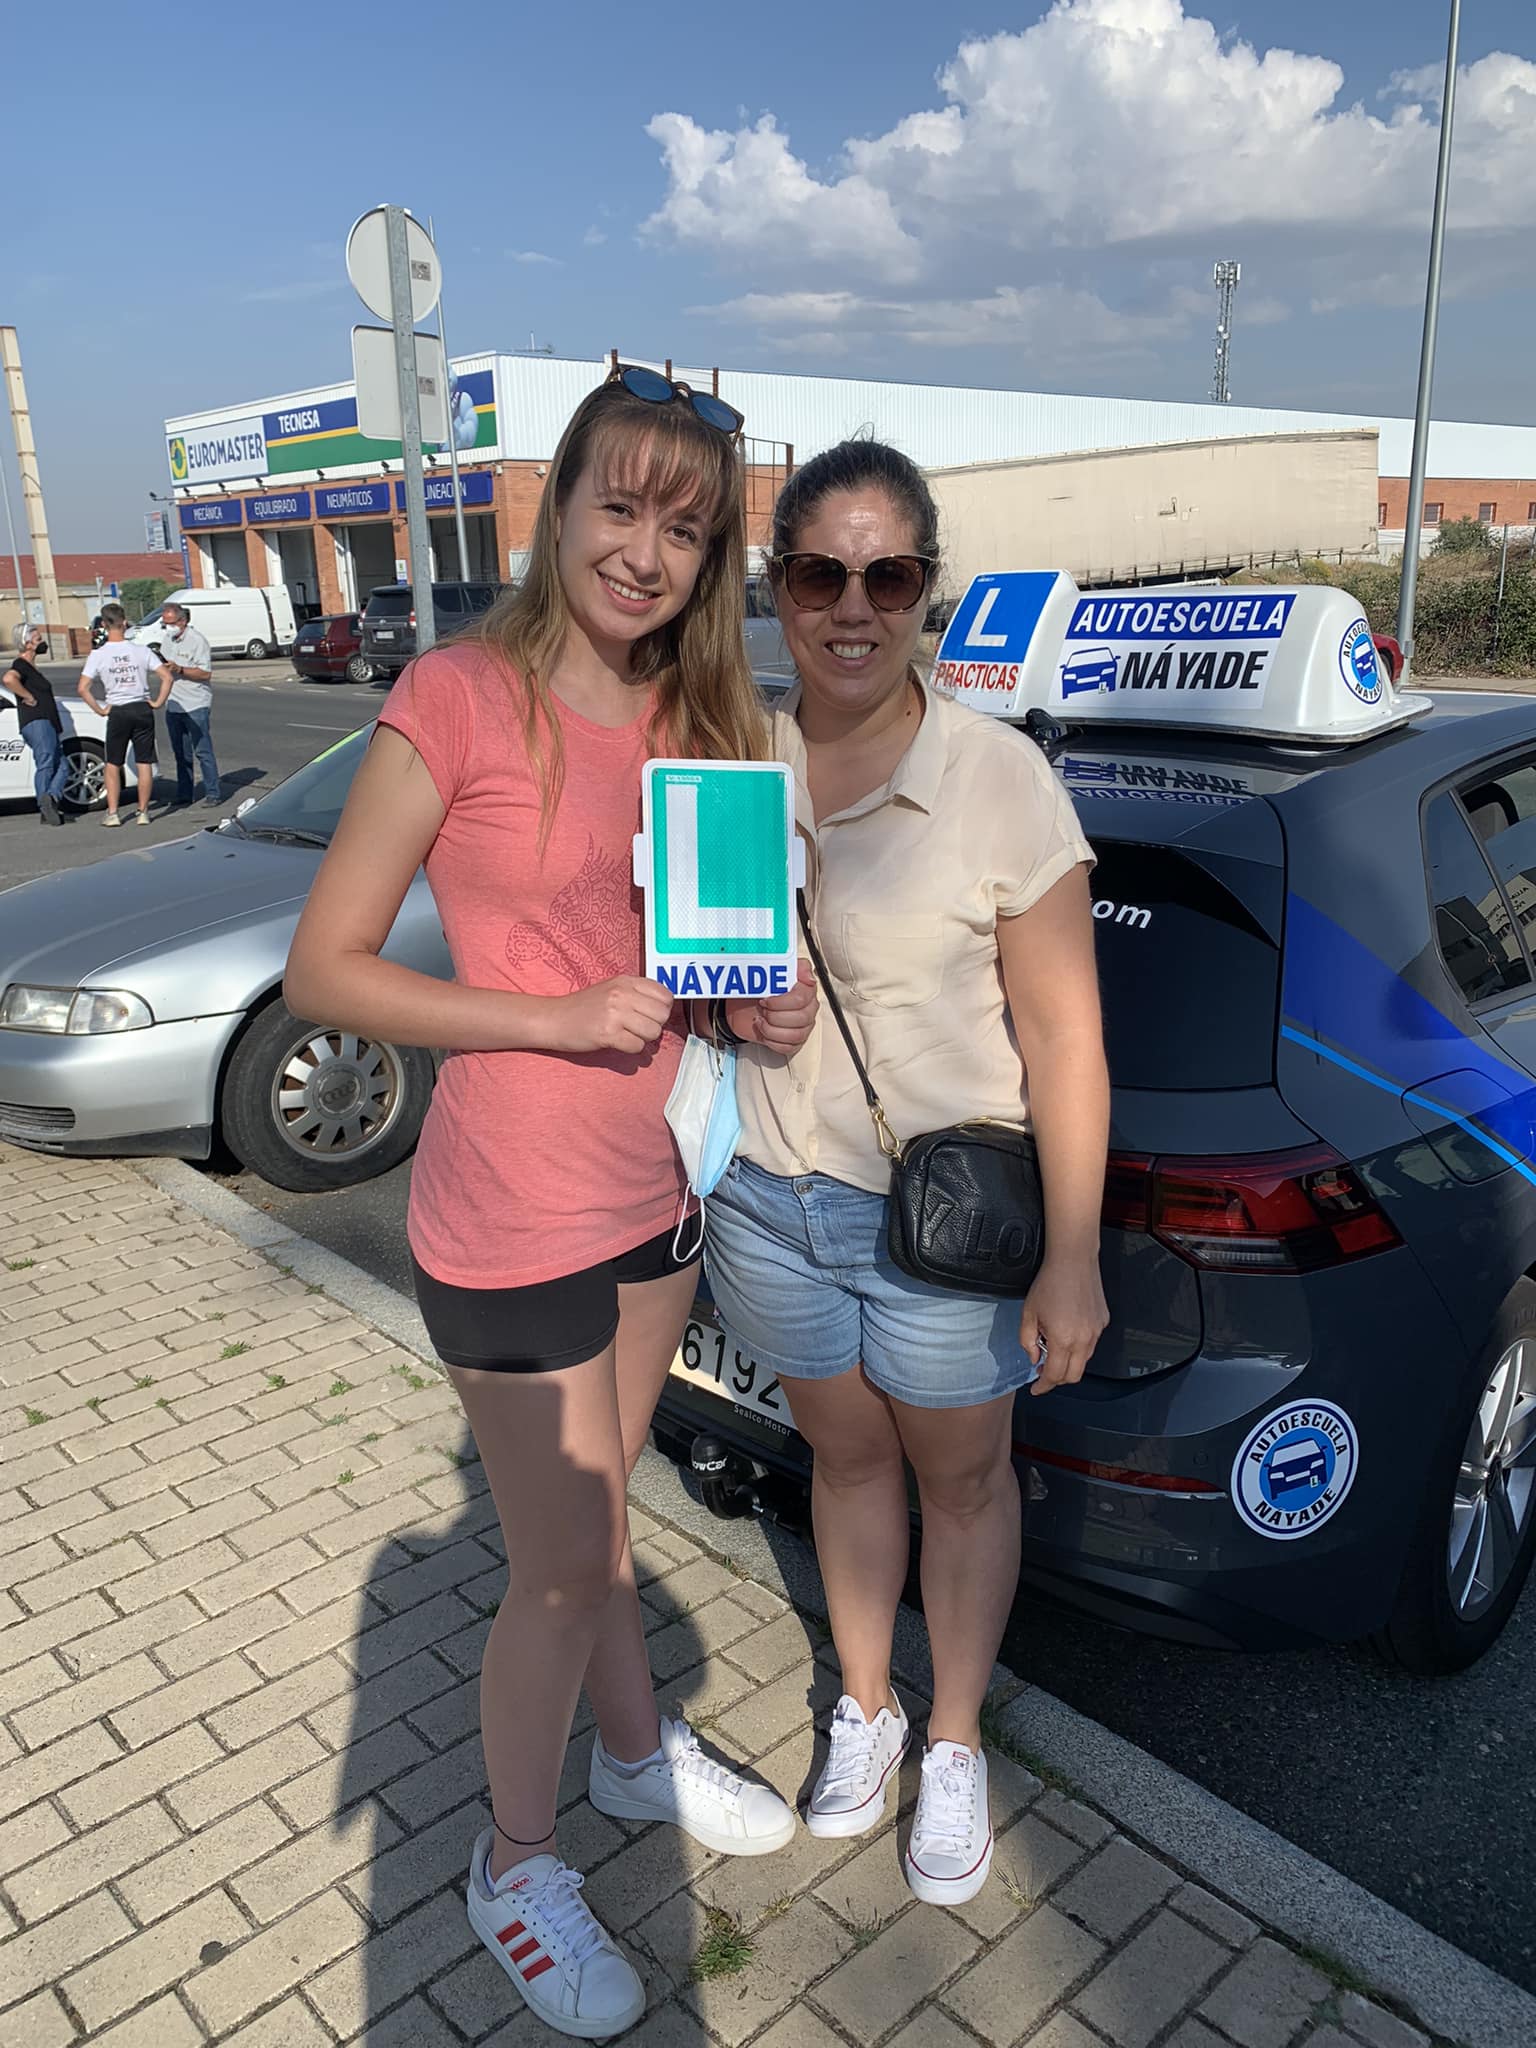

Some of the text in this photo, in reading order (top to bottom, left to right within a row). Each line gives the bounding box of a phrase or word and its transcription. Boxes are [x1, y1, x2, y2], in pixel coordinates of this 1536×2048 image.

[278, 409, 321, 434] TECNESA
[188, 432, 265, 469] EUROMASTER
[193, 505, 223, 521] MECÁNICA
[253, 498, 297, 519] EQUILIBRADO
[326, 488, 373, 509] NEUMÁTICOS
[964, 587, 1008, 647] L
[1074, 599, 1286, 633] AUTOESCUELA
[109, 665, 140, 675] NORTH
[112, 655, 130, 664] THE
[1120, 643, 1269, 690] NÁYADE
[115, 676, 137, 684] FACE
[935, 662, 1019, 691] PRACTICAS
[665, 783, 775, 940] L
[656, 961, 789, 995] NÁYADE
[681, 1322, 780, 1410] 6192
[733, 1404, 792, 1437] Sealco Motor
[1249, 1411, 1347, 1464] AUTOESCUELA
